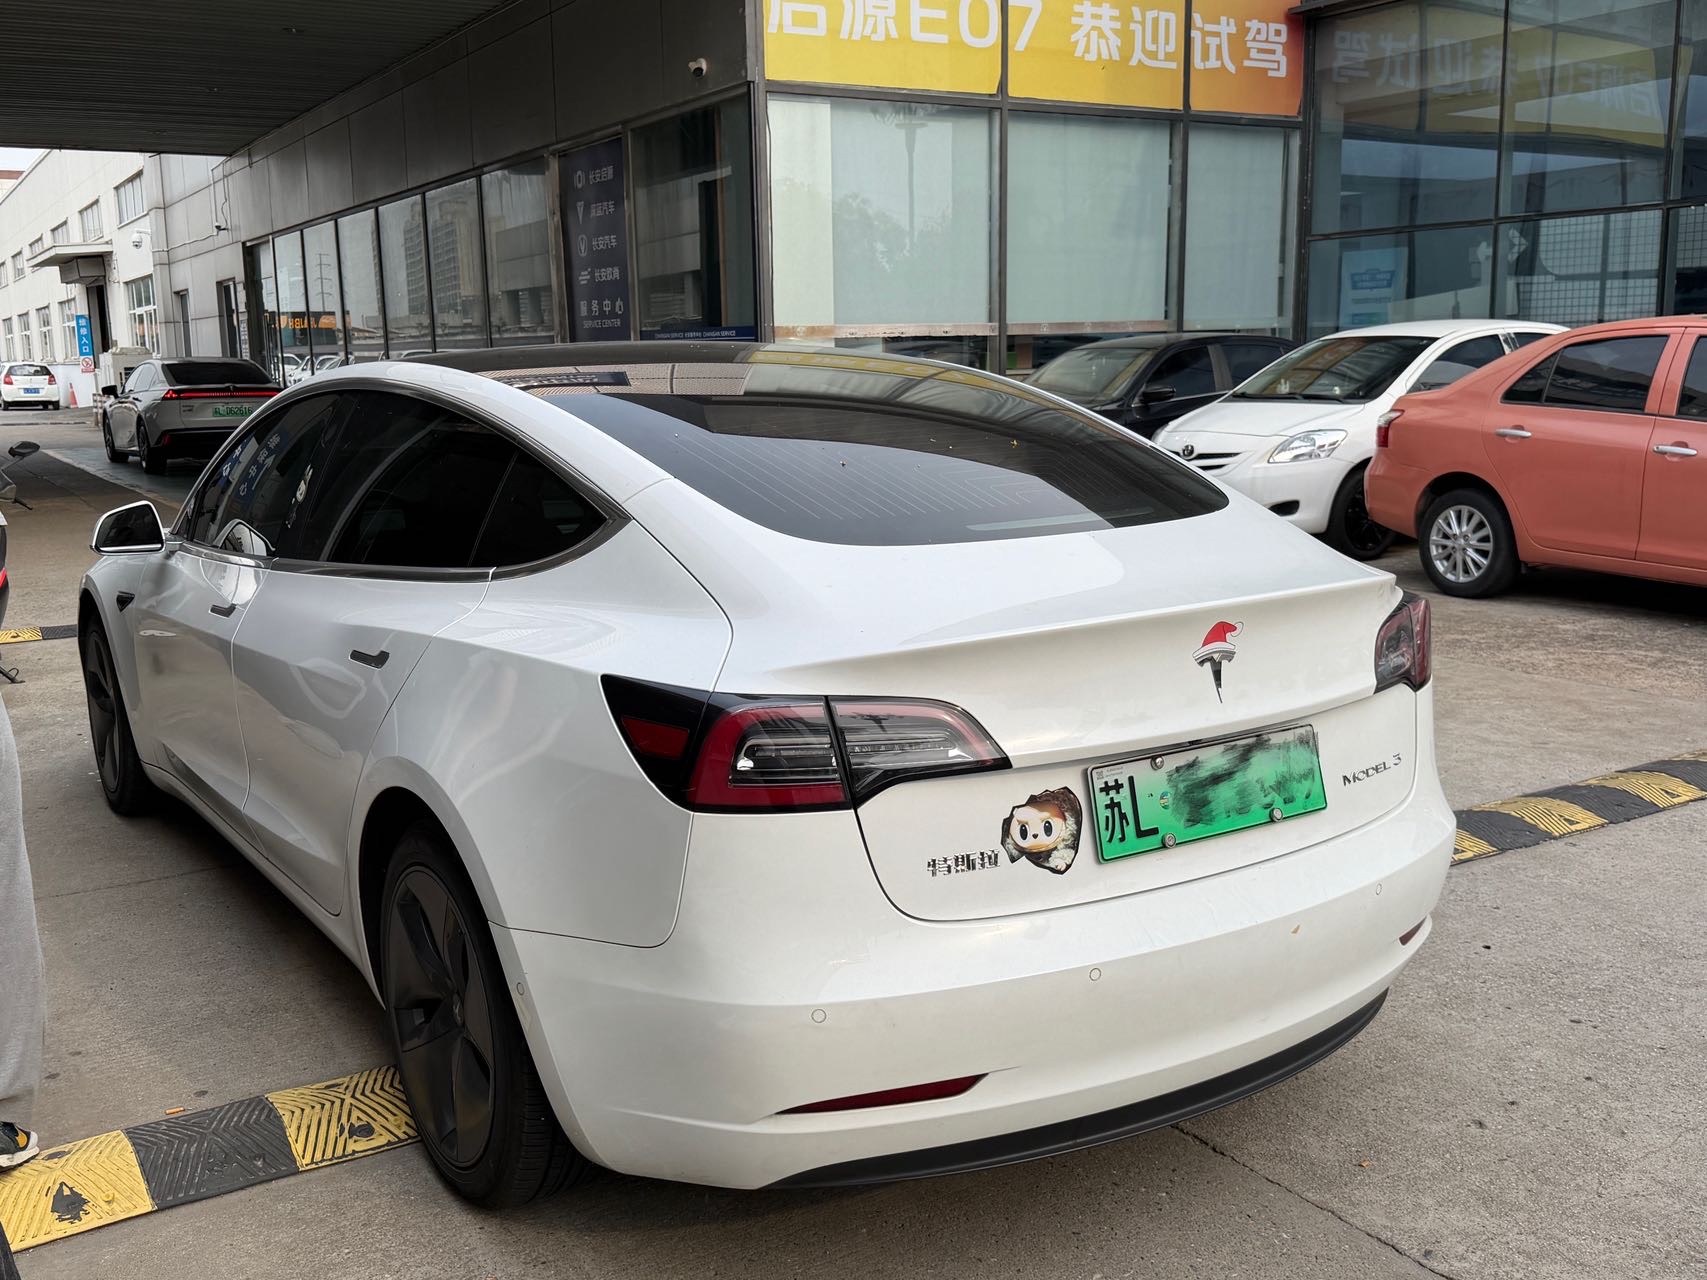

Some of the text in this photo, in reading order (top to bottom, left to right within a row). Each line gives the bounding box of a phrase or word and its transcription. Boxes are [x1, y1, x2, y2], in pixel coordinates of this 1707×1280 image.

[1071, 0, 1287, 78] 恭迎试驾
[580, 297, 624, 316] 服务中心
[583, 319, 621, 328] SERVICE CENTER
[1342, 752, 1402, 787] MODEL 3
[1099, 775, 1159, 843] 苏L
[927, 848, 1000, 877] 特斯拉
